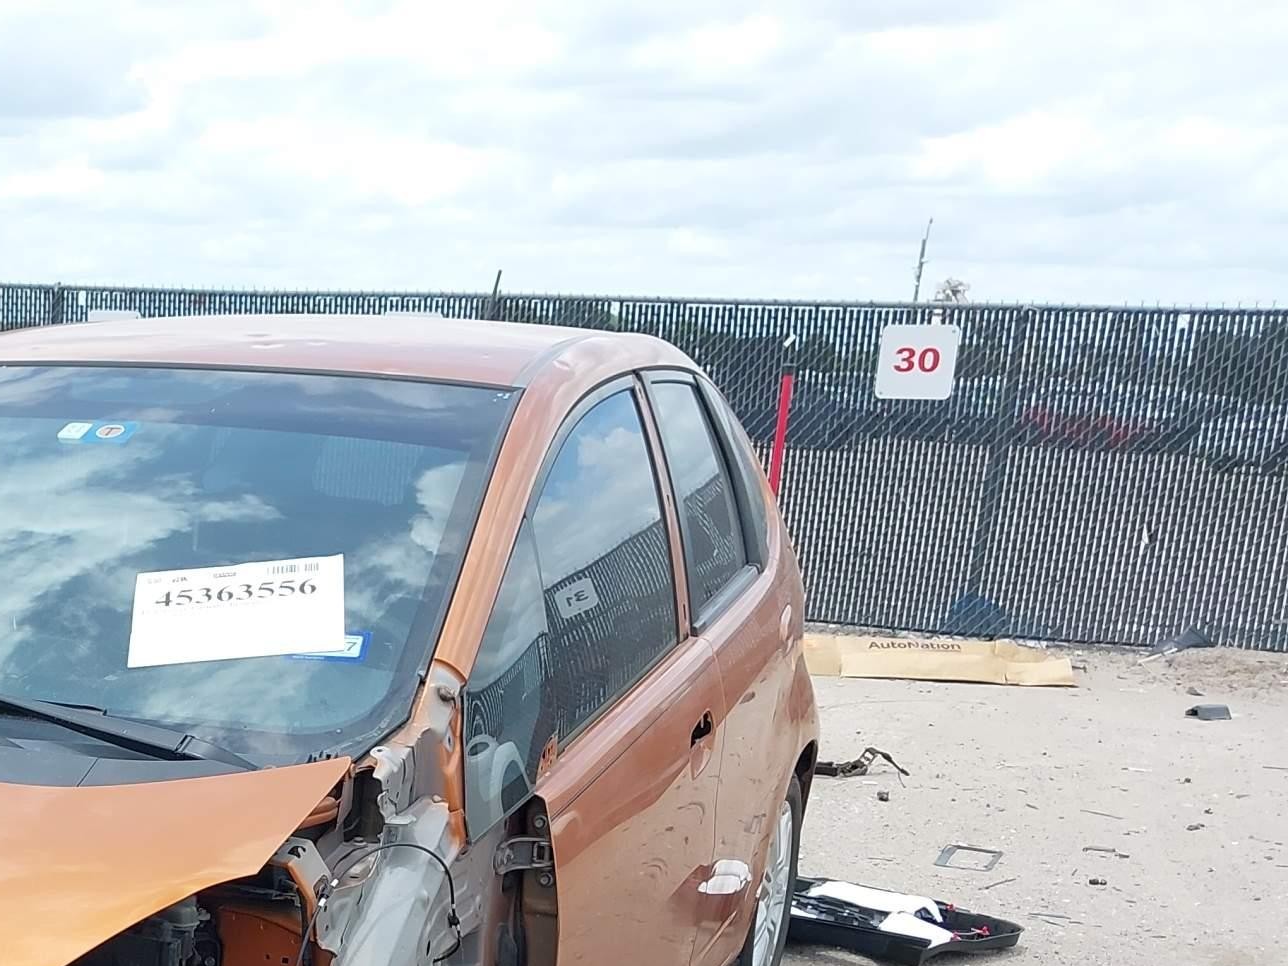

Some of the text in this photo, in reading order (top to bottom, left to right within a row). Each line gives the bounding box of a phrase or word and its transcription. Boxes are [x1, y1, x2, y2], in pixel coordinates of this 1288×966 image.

[893, 347, 941, 373] 30
[154, 578, 318, 607] 45363556
[868, 640, 962, 651] AutoNation
